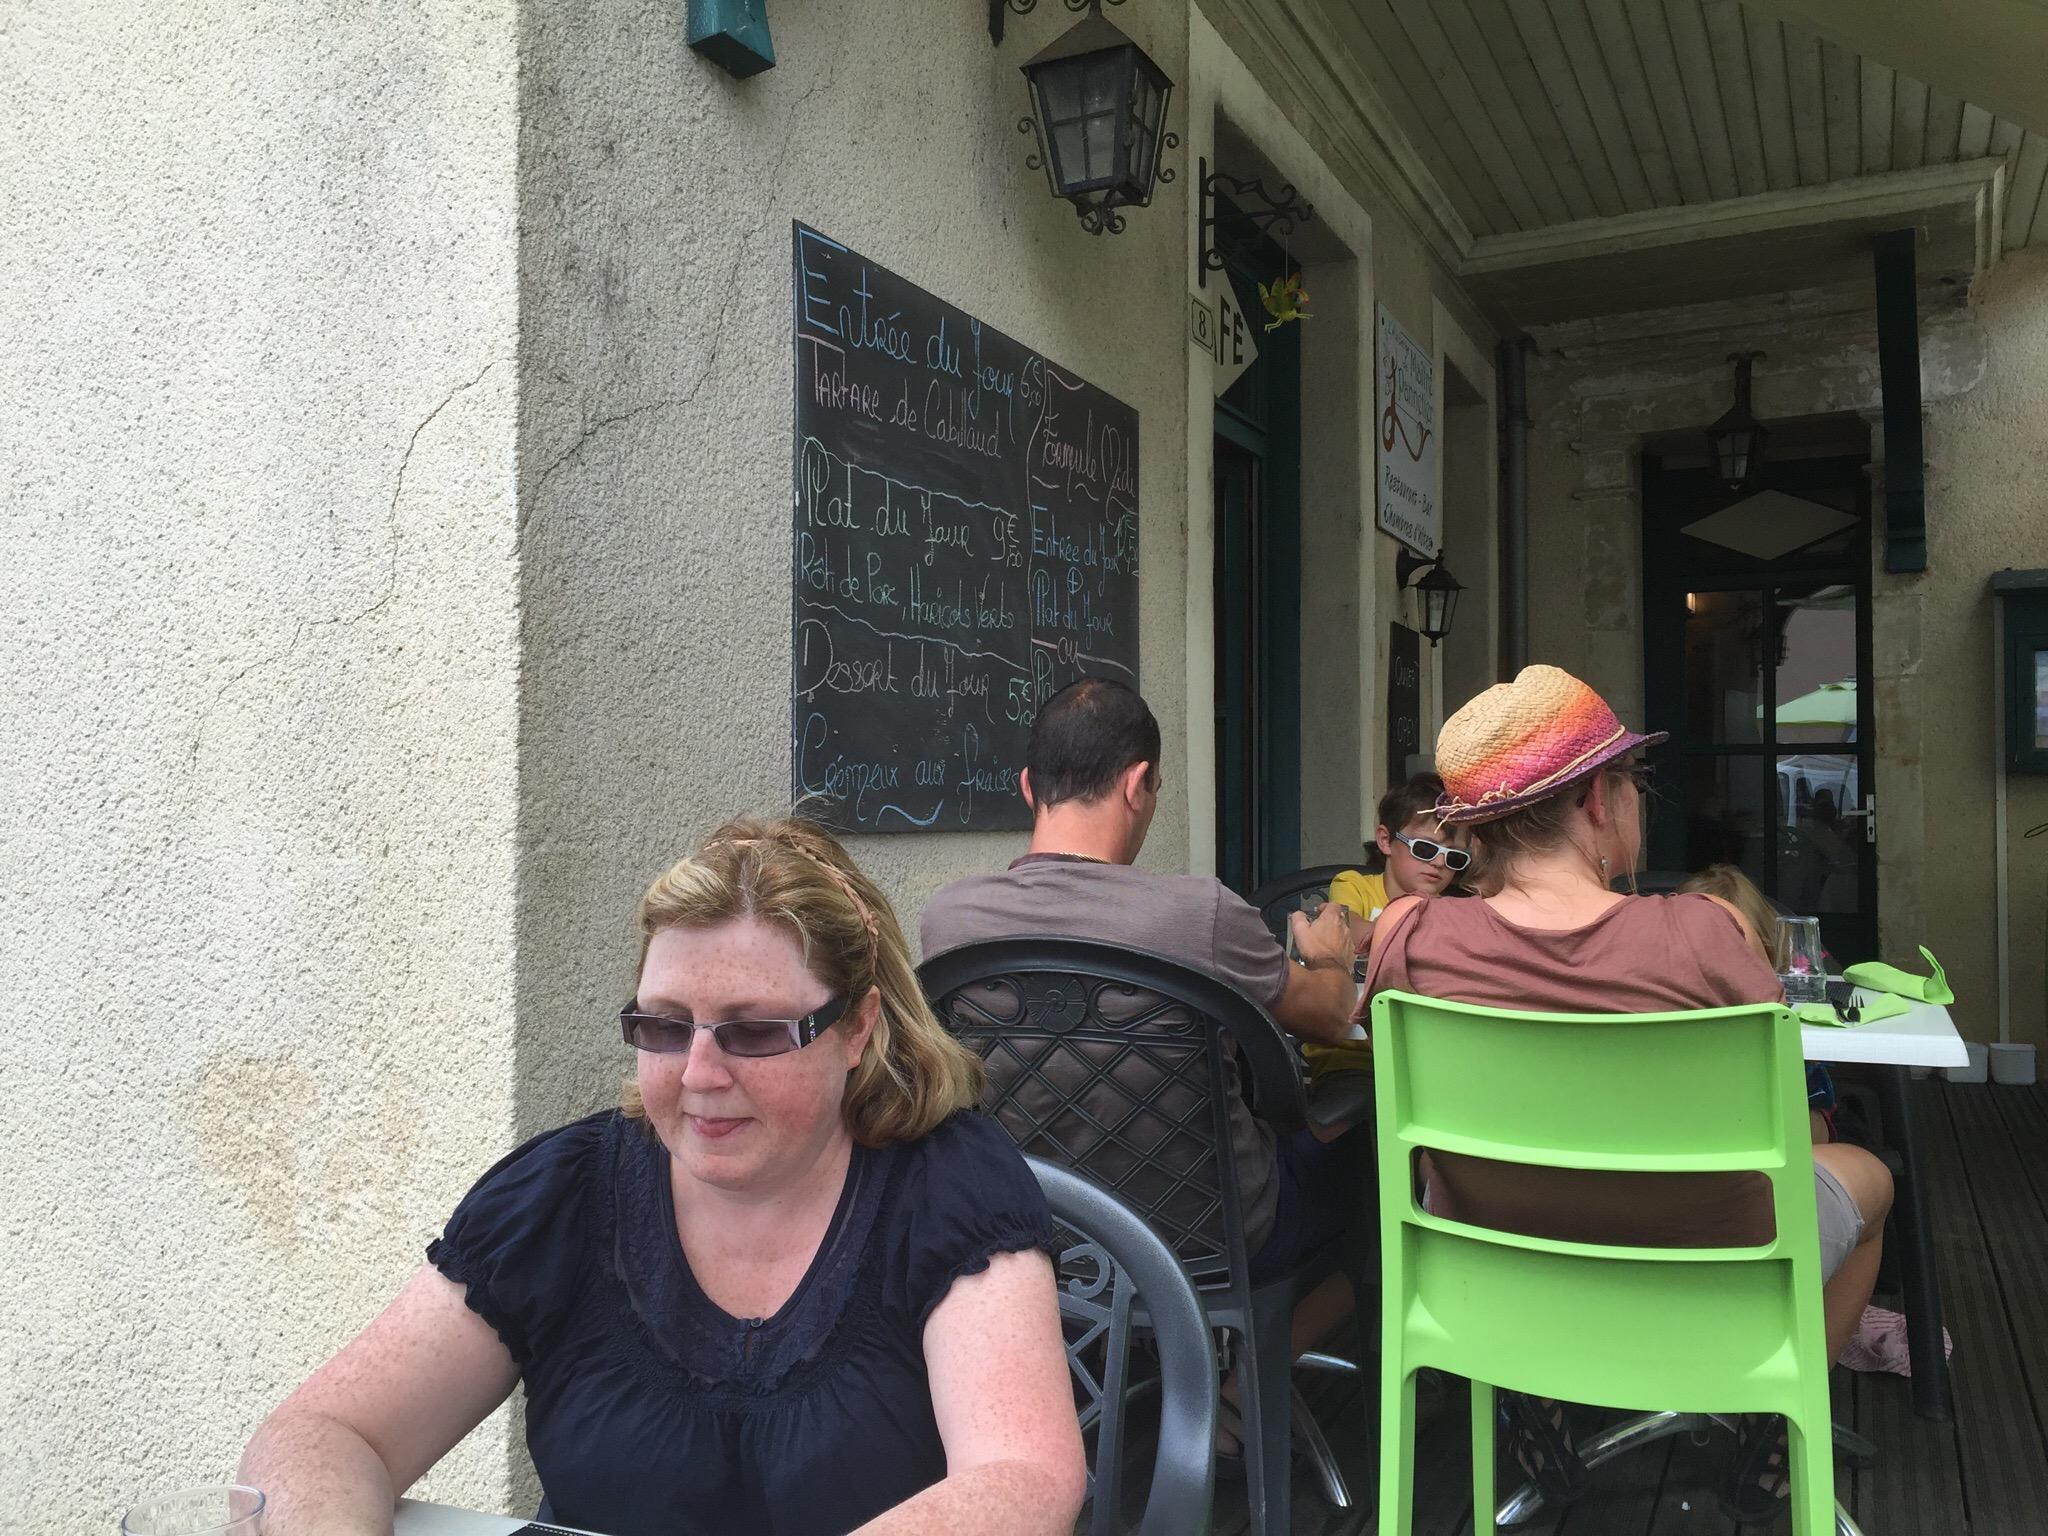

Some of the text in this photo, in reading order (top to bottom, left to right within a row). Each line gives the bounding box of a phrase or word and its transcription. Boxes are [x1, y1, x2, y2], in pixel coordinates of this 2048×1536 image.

[926, 316, 962, 378] du
[1199, 310, 1207, 339] 8
[889, 378, 917, 432] de
[800, 437, 860, 530] Plat
[876, 479, 911, 537] du
[1083, 522, 1098, 567] du
[840, 543, 864, 604] de
[1062, 592, 1078, 630] du
[911, 642, 941, 699] du
[914, 759, 945, 787] aux
